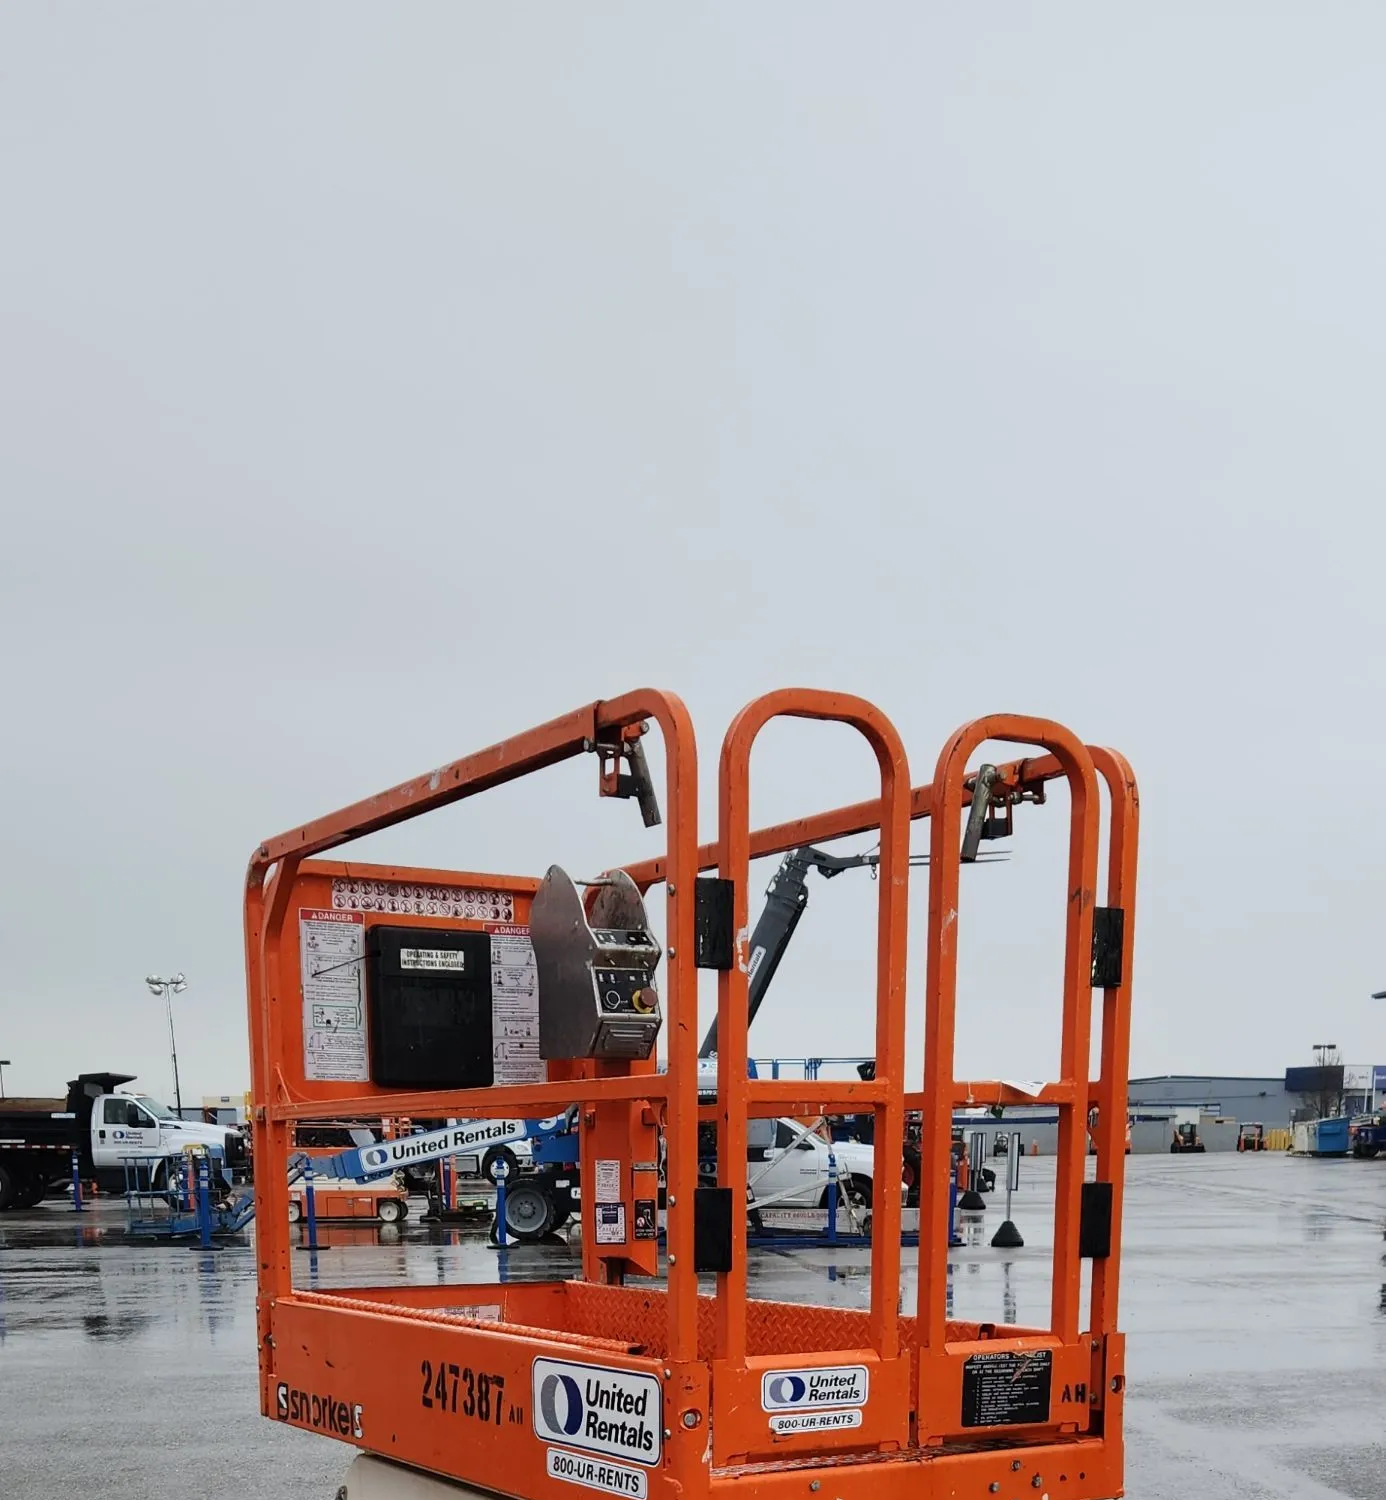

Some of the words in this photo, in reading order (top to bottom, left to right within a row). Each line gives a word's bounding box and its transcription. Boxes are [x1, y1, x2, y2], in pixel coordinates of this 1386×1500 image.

[317, 911, 354, 922] DANGER
[393, 1135, 448, 1160] United
[453, 1121, 516, 1146] Rentals
[421, 1359, 505, 1426] 247387
[808, 1387, 860, 1401] Rentals
[809, 1374, 857, 1388] United
[1061, 1383, 1086, 1403] AH
[586, 1379, 648, 1416] United
[585, 1410, 654, 1451] Rentals
[778, 1414, 854, 1429] 800-UR-RENTS
[553, 1456, 640, 1493] 800-UR-RENTS
